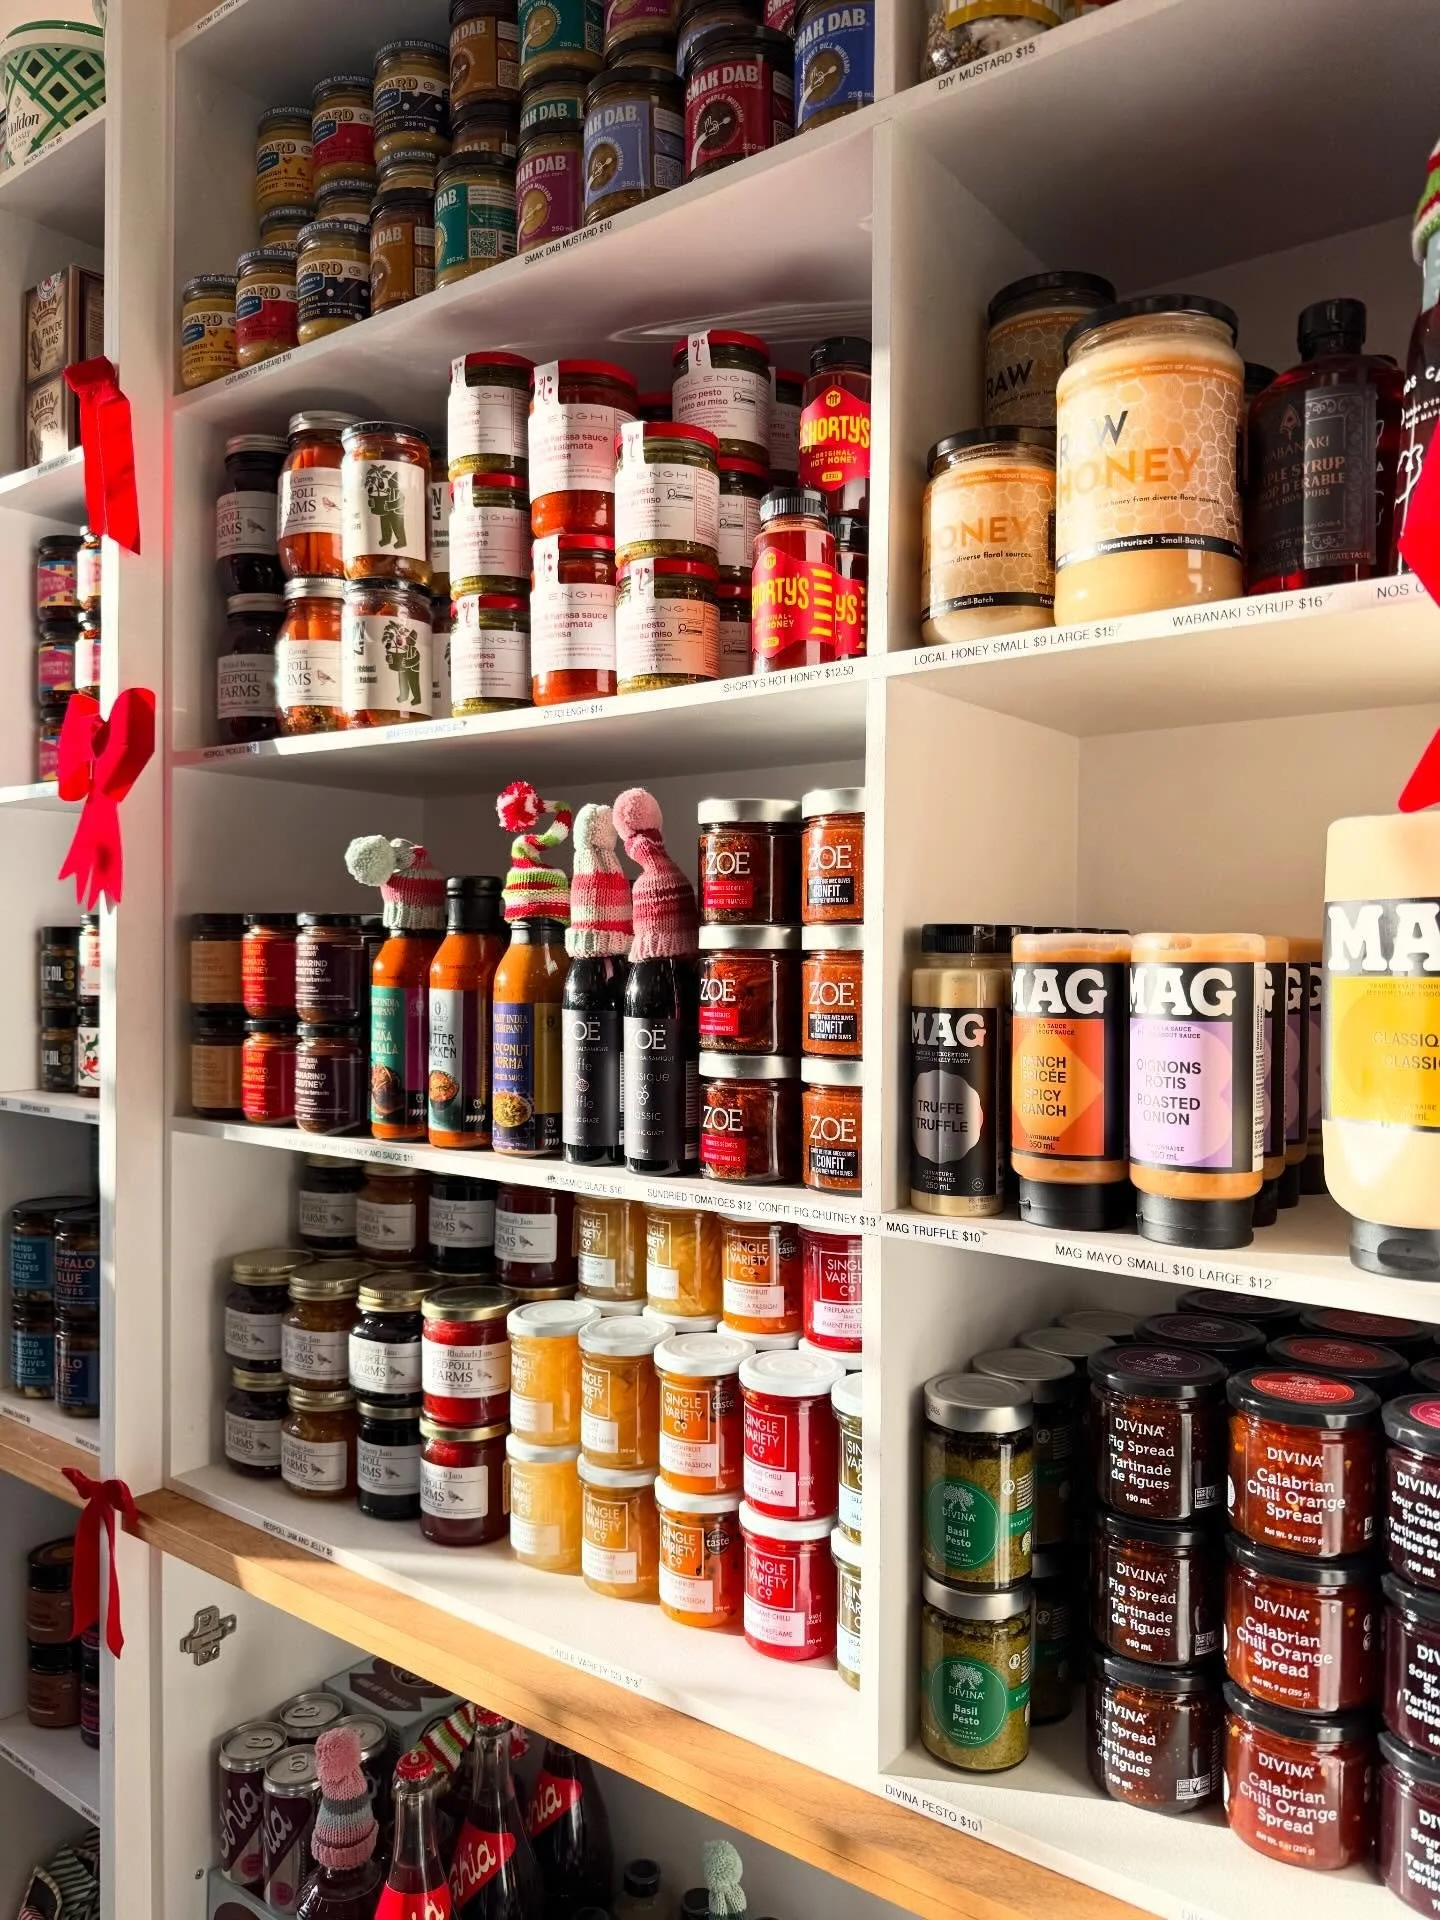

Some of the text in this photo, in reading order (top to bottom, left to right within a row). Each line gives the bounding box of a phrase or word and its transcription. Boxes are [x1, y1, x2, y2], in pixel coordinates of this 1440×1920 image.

[461, 20, 486, 35] DAB
[828, 8, 866, 31] DAB
[723, 65, 759, 83] DAB
[937, 42, 1037, 91] DIY MUSTARD $15
[539, 103, 567, 119] DAB
[604, 106, 637, 125] DAB
[535, 155, 567, 172] DAB
[437, 189, 457, 209] DAB
[524, 220, 613, 265] SMAK DAB MUSTARD $10
[258, 357, 281, 372] MUSTARD
[698, 389, 722, 399] pesto
[708, 398, 728, 406] miso
[583, 434, 608, 442] sauce
[800, 414, 870, 454] SHORTY'S
[828, 456, 857, 465] HONEY
[1098, 537, 1153, 552] Unpasteurized
[957, 551, 1003, 563] diverse floral
[1376, 583, 1410, 599] NOS
[582, 612, 608, 620] sauce
[1172, 595, 1323, 628] WABANAKI SYRUP $16
[914, 625, 1115, 666] LOCAL HONEY SMALL $9 LARGE $15
[723, 665, 854, 693] SHORTY'S HOT HONEY $12.50
[220, 683, 261, 698] FARMS
[590, 705, 603, 714] $14
[813, 884, 841, 897] CONFIT
[815, 1020, 843, 1033] CONFIT
[911, 1013, 986, 1048] MAG
[1137, 1058, 1202, 1075] OIGNONS
[1024, 1089, 1061, 1102] SPICY
[1138, 1093, 1200, 1111] ROASTED
[918, 1099, 964, 1115] TRUFFE
[1022, 1103, 1066, 1117] RANCH
[915, 1117, 968, 1133] TRUFFLE
[1143, 1110, 1190, 1125] ONION
[369, 1150, 402, 1161] AND SAUCE
[816, 1155, 846, 1169] CONFIT
[585, 1183, 607, 1193] GLAZE
[940, 1182, 951, 1191] mL
[648, 1188, 751, 1210] SUNDRIED TOMATOES $12
[759, 1202, 790, 1214] CONFIT
[812, 1210, 857, 1223] CHUTNEY
[859, 1217, 876, 1227] $13
[886, 1222, 981, 1244] MAG TRUFFLE $10
[730, 1241, 768, 1254] SINGLE
[730, 1255, 769, 1266] VARIETY
[1055, 1242, 1272, 1290] MAG MAYO SMALL $10 LARGE $12
[57, 1273, 82, 1284] BLUE
[432, 1371, 473, 1382] FARMS
[664, 1391, 701, 1409] SINGLE
[664, 1404, 703, 1422] VARIETY
[746, 1414, 778, 1434] SINGLE
[1115, 1417, 1165, 1437] DIVINA
[745, 1428, 780, 1448] VARIETY
[1127, 1440, 1175, 1457] Spread
[1267, 1447, 1325, 1467] DIVINA
[1110, 1452, 1172, 1476] Tartinade
[1111, 1467, 1170, 1491] de figues
[1256, 1467, 1335, 1493] Calabrian
[1125, 1493, 1138, 1503] 190
[1247, 1480, 1346, 1511] Chili Orange
[1391, 1490, 1413, 1510] Sour
[942, 1507, 977, 1522] DIVINA
[1266, 1502, 1323, 1526] Spread
[662, 1526, 695, 1547] SINGLE
[706, 1536, 730, 1547] taste
[946, 1535, 971, 1548] Pesto
[947, 1525, 969, 1538] Basil
[1389, 1516, 1438, 1549] Tartinade
[660, 1538, 697, 1559] VARIETY
[1390, 1531, 1424, 1556] cerises
[750, 1556, 787, 1577] SINGLE
[1116, 1562, 1167, 1584] DIVINA
[748, 1570, 789, 1590] VARIETY
[1109, 1577, 1176, 1605] Fig Spread
[1110, 1597, 1173, 1623] Tartinade
[1254, 1596, 1311, 1622] DIVINA
[1111, 1612, 1171, 1637] de figues
[1245, 1616, 1321, 1648] Calabrian
[1236, 1628, 1333, 1665] Chili Orange
[1253, 1651, 1310, 1679] Spread
[1408, 1664, 1438, 1685] Sour
[948, 1686, 985, 1700] DIVINA
[952, 1713, 980, 1726] Pesto
[954, 1703, 978, 1716] Basil
[1111, 1718, 1156, 1747] Spread
[1096, 1729, 1153, 1765] Tartinade
[1097, 1746, 1151, 1777] de figues
[1258, 1752, 1315, 1779] DIVINA
[1248, 1772, 1326, 1805] Calabrian
[885, 1783, 978, 1832] DIVINA PESTO $10
[1239, 1780, 1272, 1809] Chili
[1275, 1797, 1337, 1822] Orange
[1257, 1806, 1314, 1835] Spread
